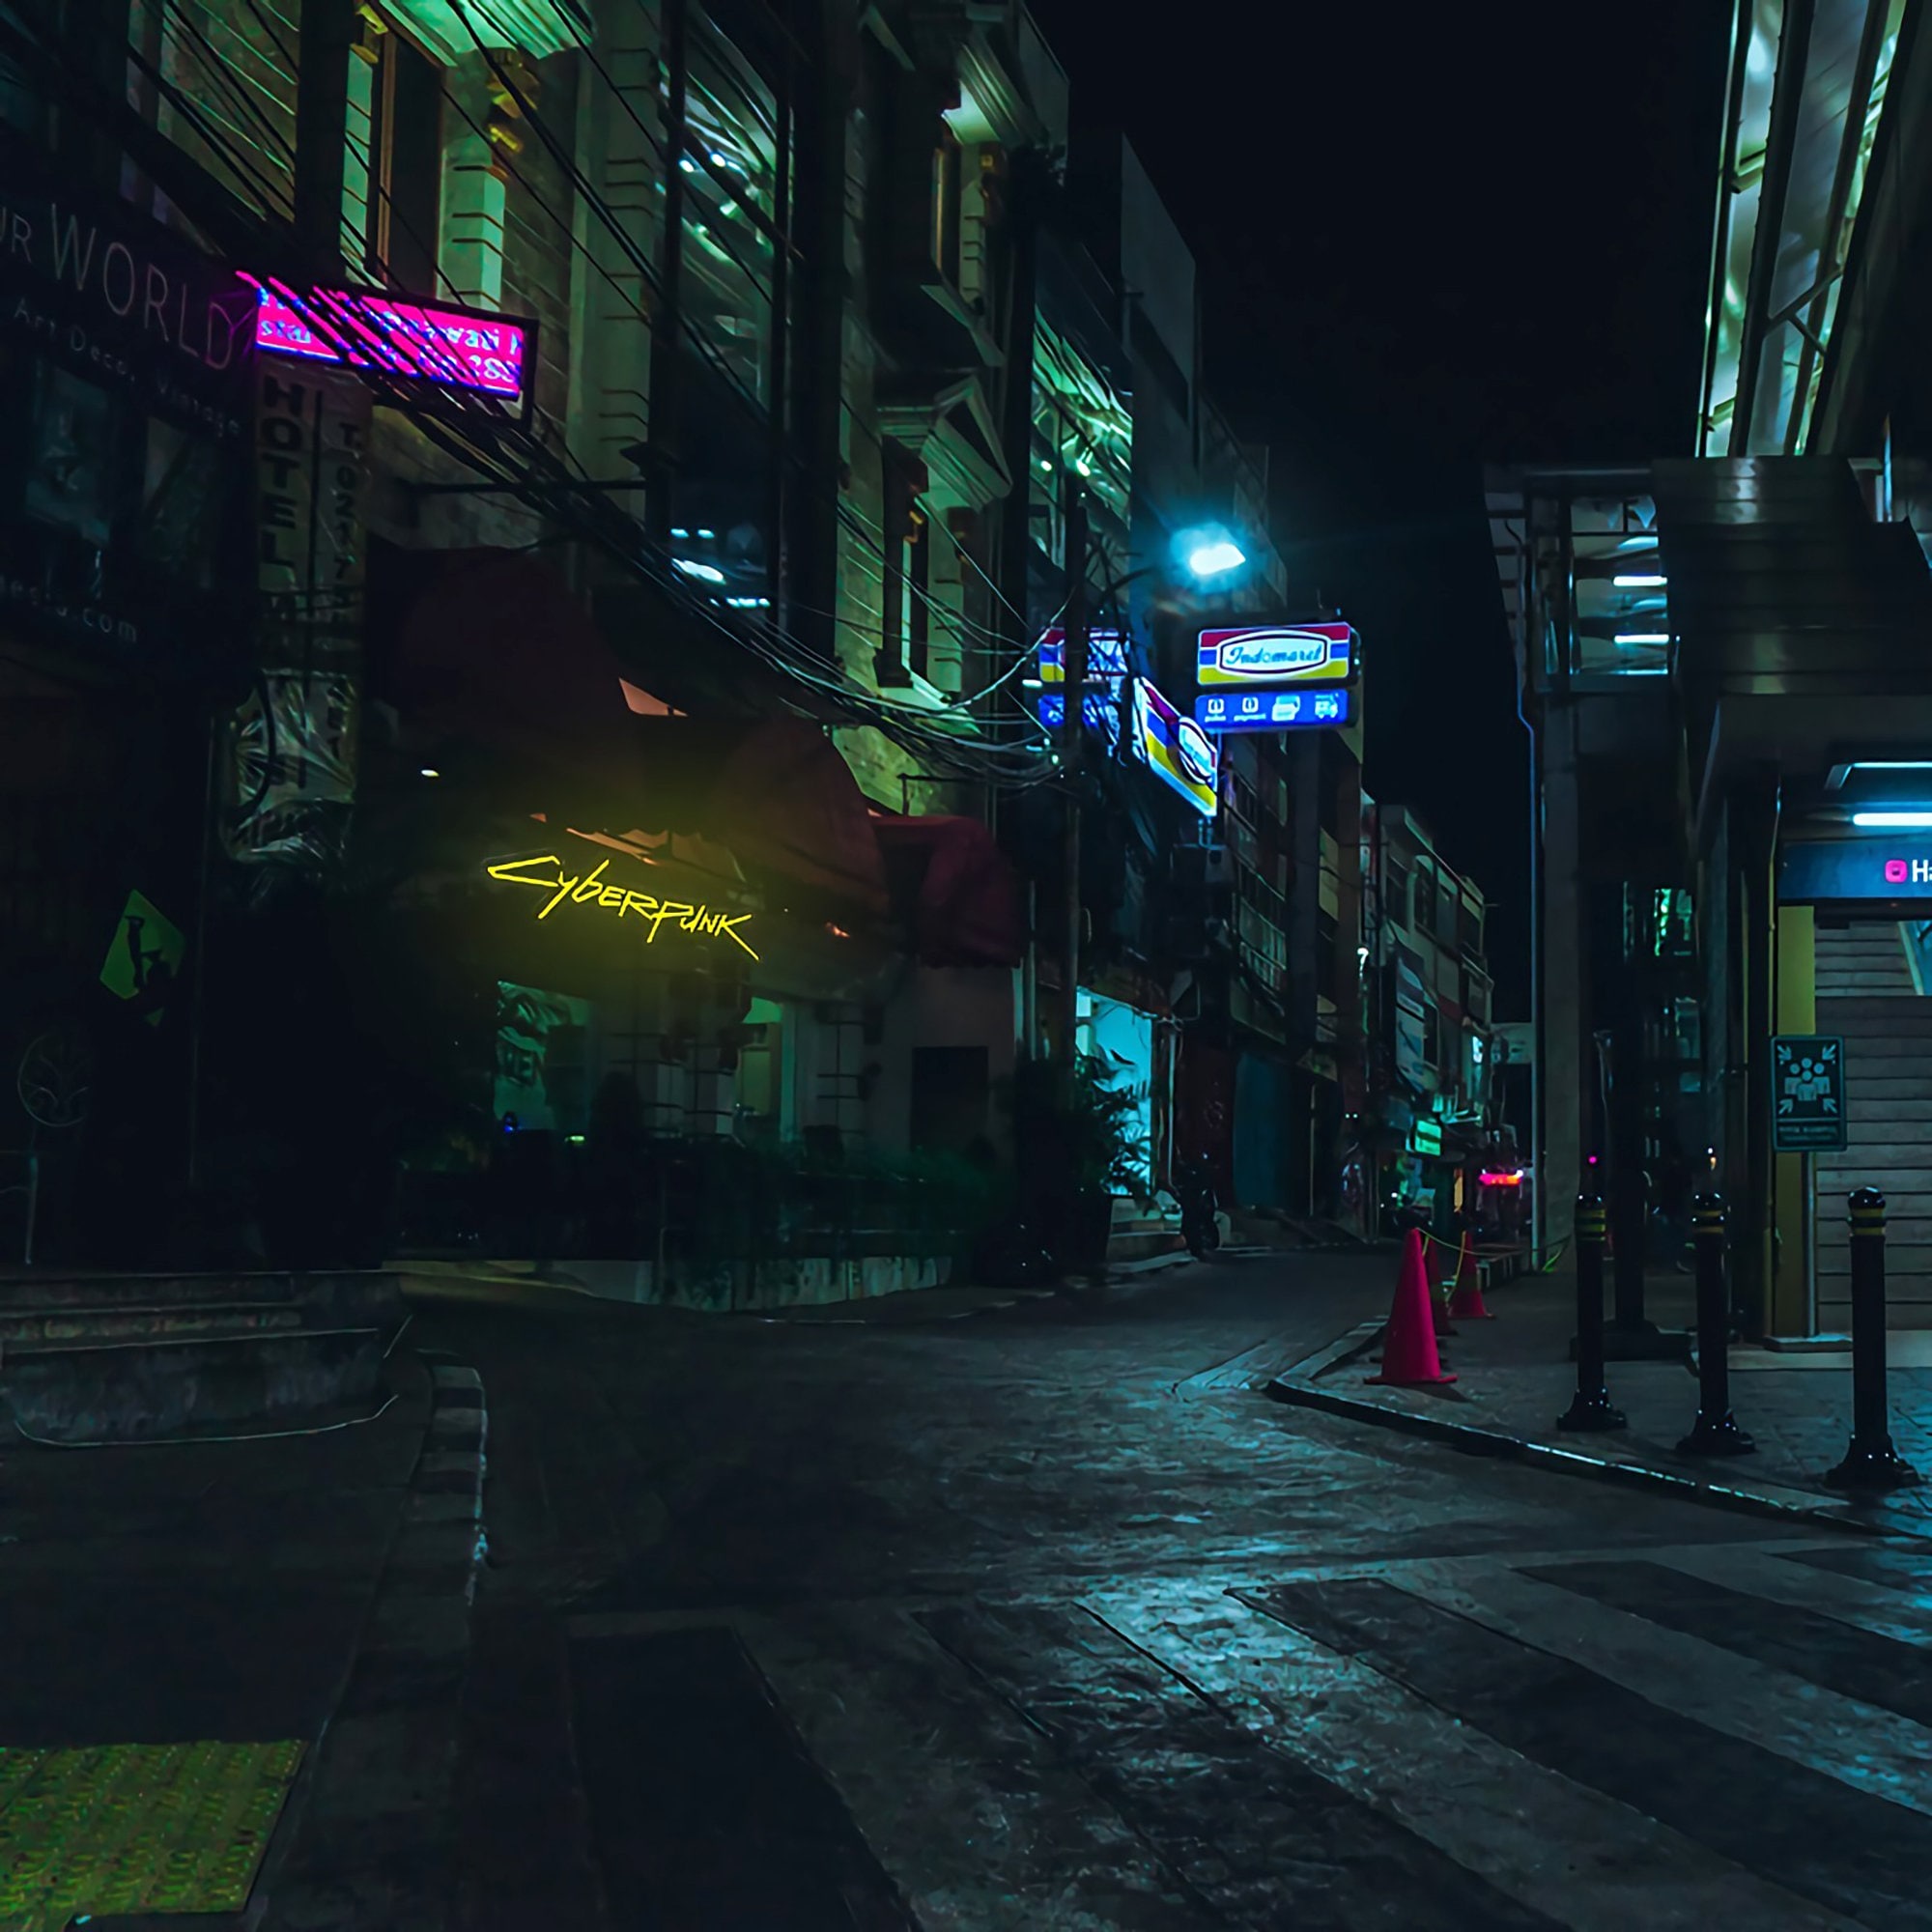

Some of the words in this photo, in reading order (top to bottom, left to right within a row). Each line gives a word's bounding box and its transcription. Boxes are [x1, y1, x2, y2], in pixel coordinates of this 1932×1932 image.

[51, 202, 234, 370] WORLD
[260, 374, 305, 568] HOTEL
[1225, 643, 1322, 666] Indomaret
